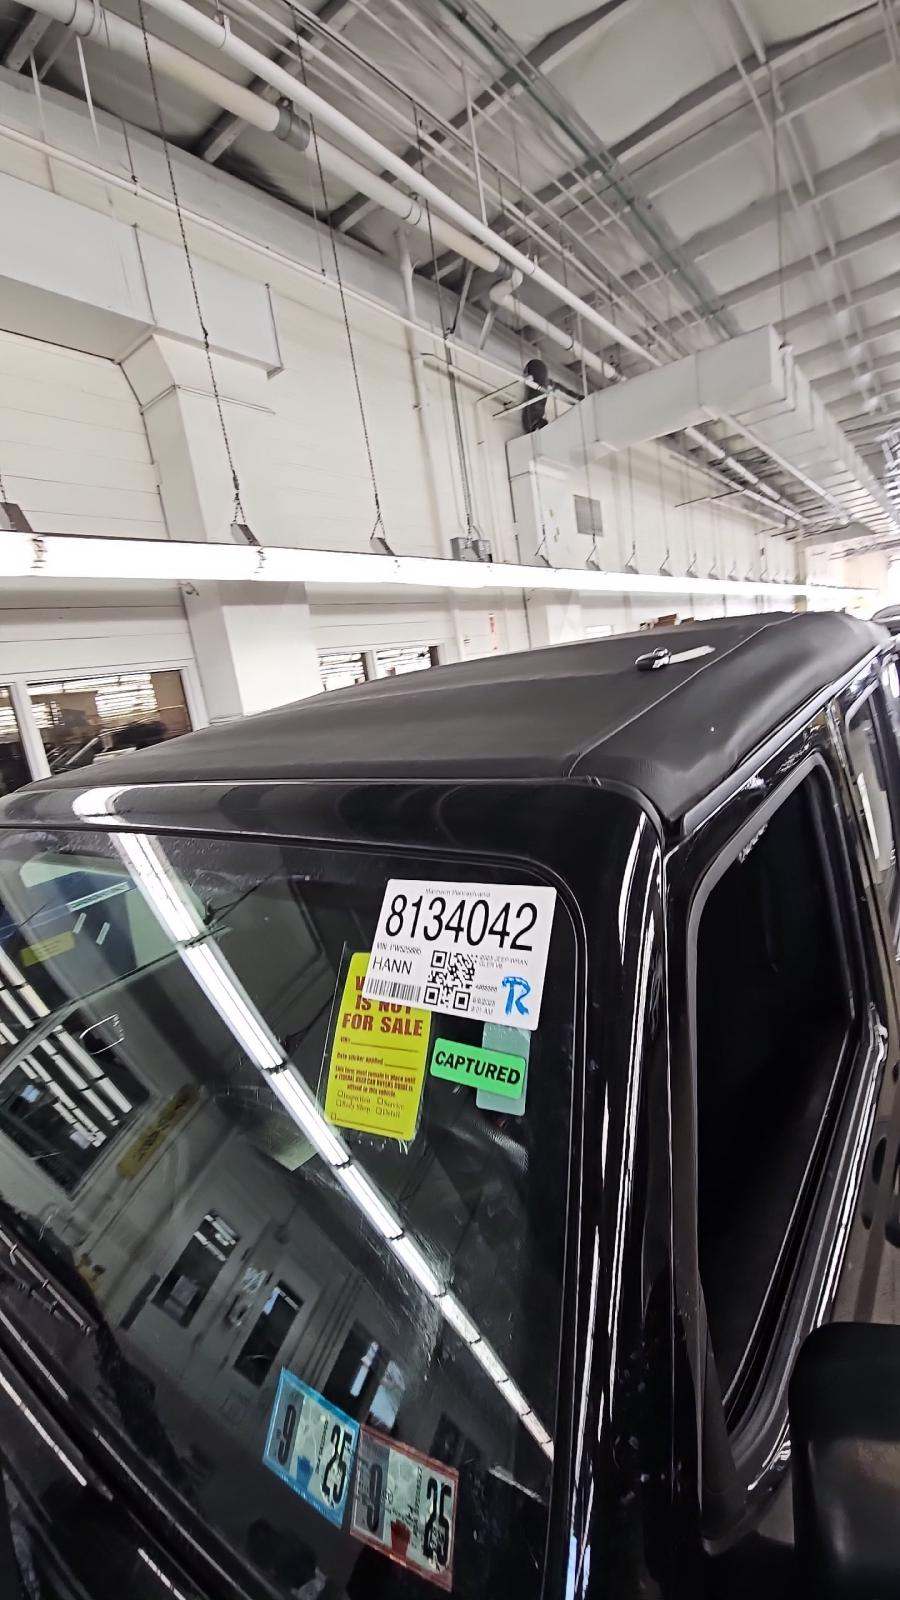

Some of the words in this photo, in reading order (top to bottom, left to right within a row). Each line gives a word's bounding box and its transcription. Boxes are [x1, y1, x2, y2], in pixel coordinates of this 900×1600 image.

[386, 894, 538, 951] 8134042
[372, 955, 413, 975] HANN
[355, 994, 371, 1011] IS
[502, 976, 531, 1016] R
[342, 1013, 374, 1032] FOR
[380, 1016, 423, 1037] SALE
[337, 1052, 347, 1060] Date
[435, 1051, 520, 1085] CAPTURED
[321, 1424, 353, 1504] 25
[422, 1477, 452, 1566] 25
